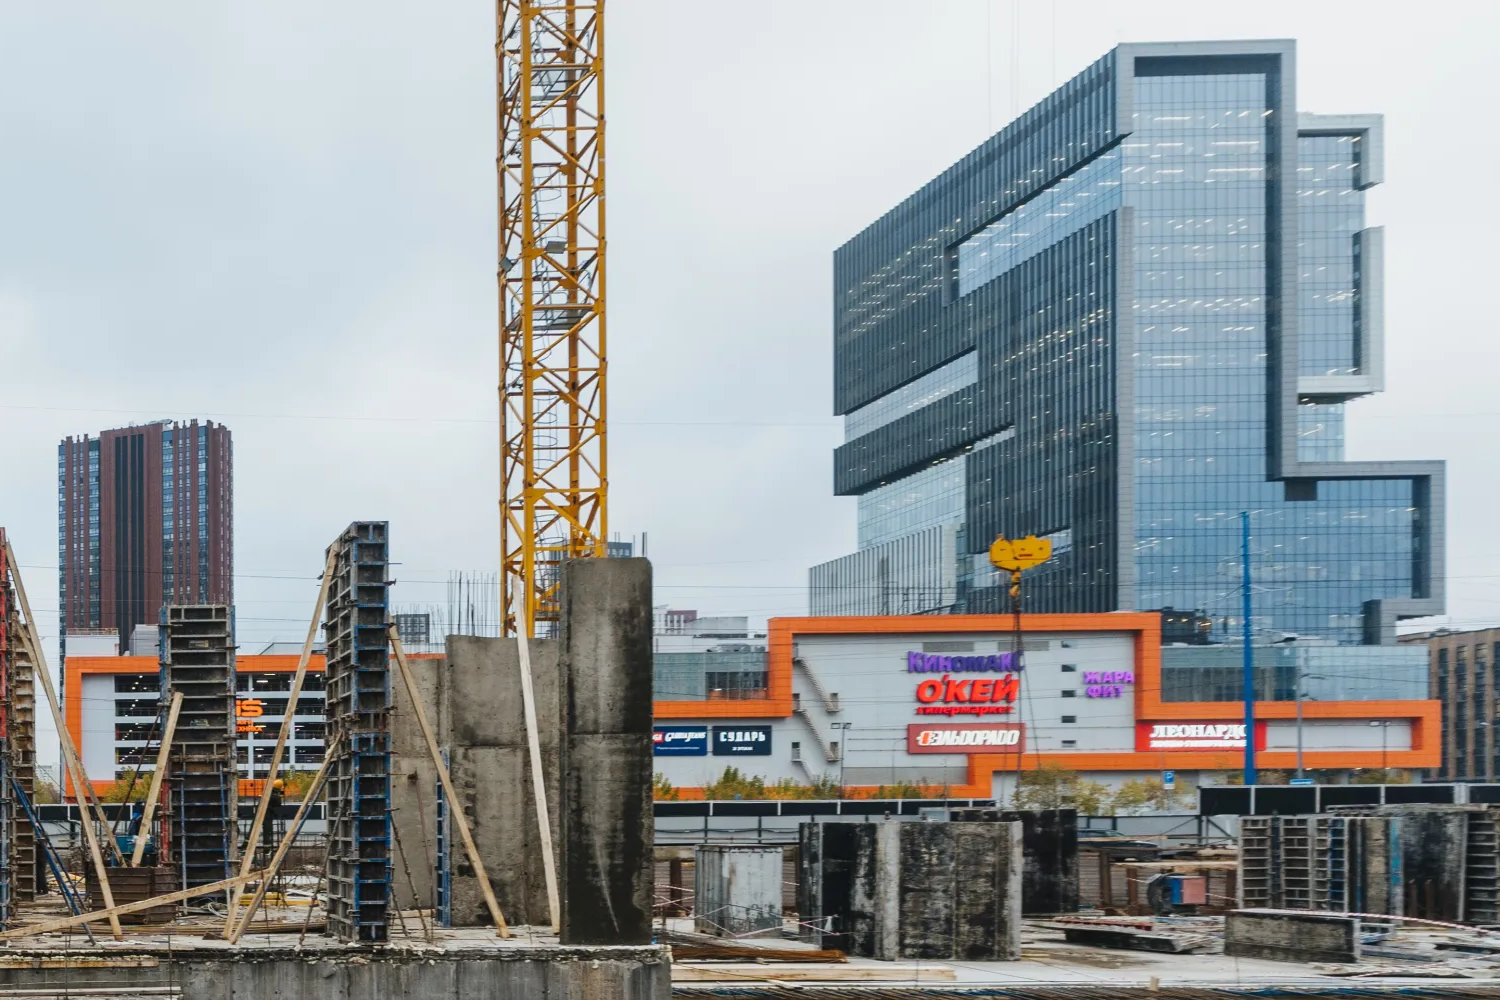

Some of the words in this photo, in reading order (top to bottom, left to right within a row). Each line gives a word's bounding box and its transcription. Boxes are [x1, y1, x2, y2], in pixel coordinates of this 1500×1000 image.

[908, 650, 1024, 672] КИНОМАКС
[1084, 671, 1134, 684] ЖАРА
[1085, 685, 1123, 698] ФИТ
[720, 731, 766, 742] СУДАРЬ
